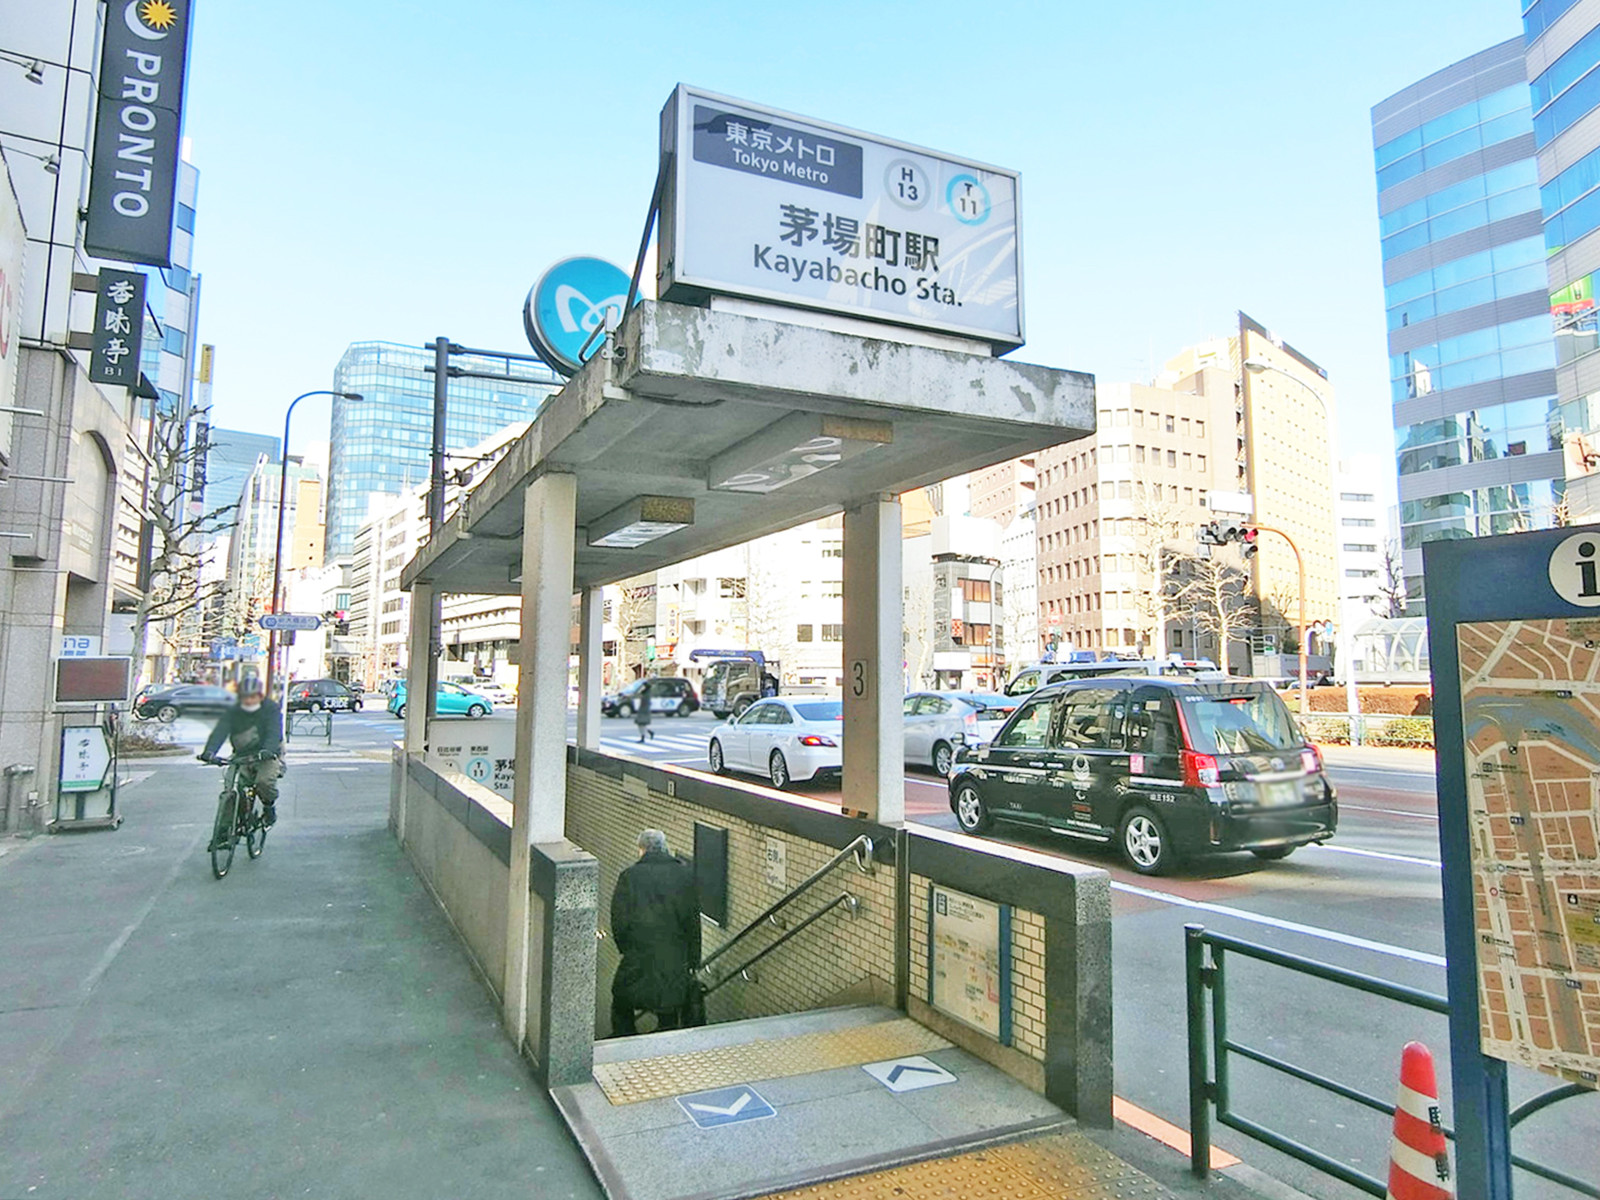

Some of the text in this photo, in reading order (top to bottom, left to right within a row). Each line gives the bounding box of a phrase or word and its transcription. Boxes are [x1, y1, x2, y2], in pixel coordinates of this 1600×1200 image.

[112, 48, 162, 218] PRONTO
[725, 121, 835, 167] 東京メトロ
[732, 147, 829, 184] Tokyo Metro
[901, 166, 914, 182] H
[897, 182, 919, 201] 13
[960, 197, 976, 215] 11
[964, 182, 973, 197] T
[779, 203, 940, 273] 茅場町駅
[753, 243, 963, 307] Kayabacho Sta.
[102, 280, 135, 365] 香味亭
[104, 366, 122, 377] B1
[853, 661, 864, 697] 3
